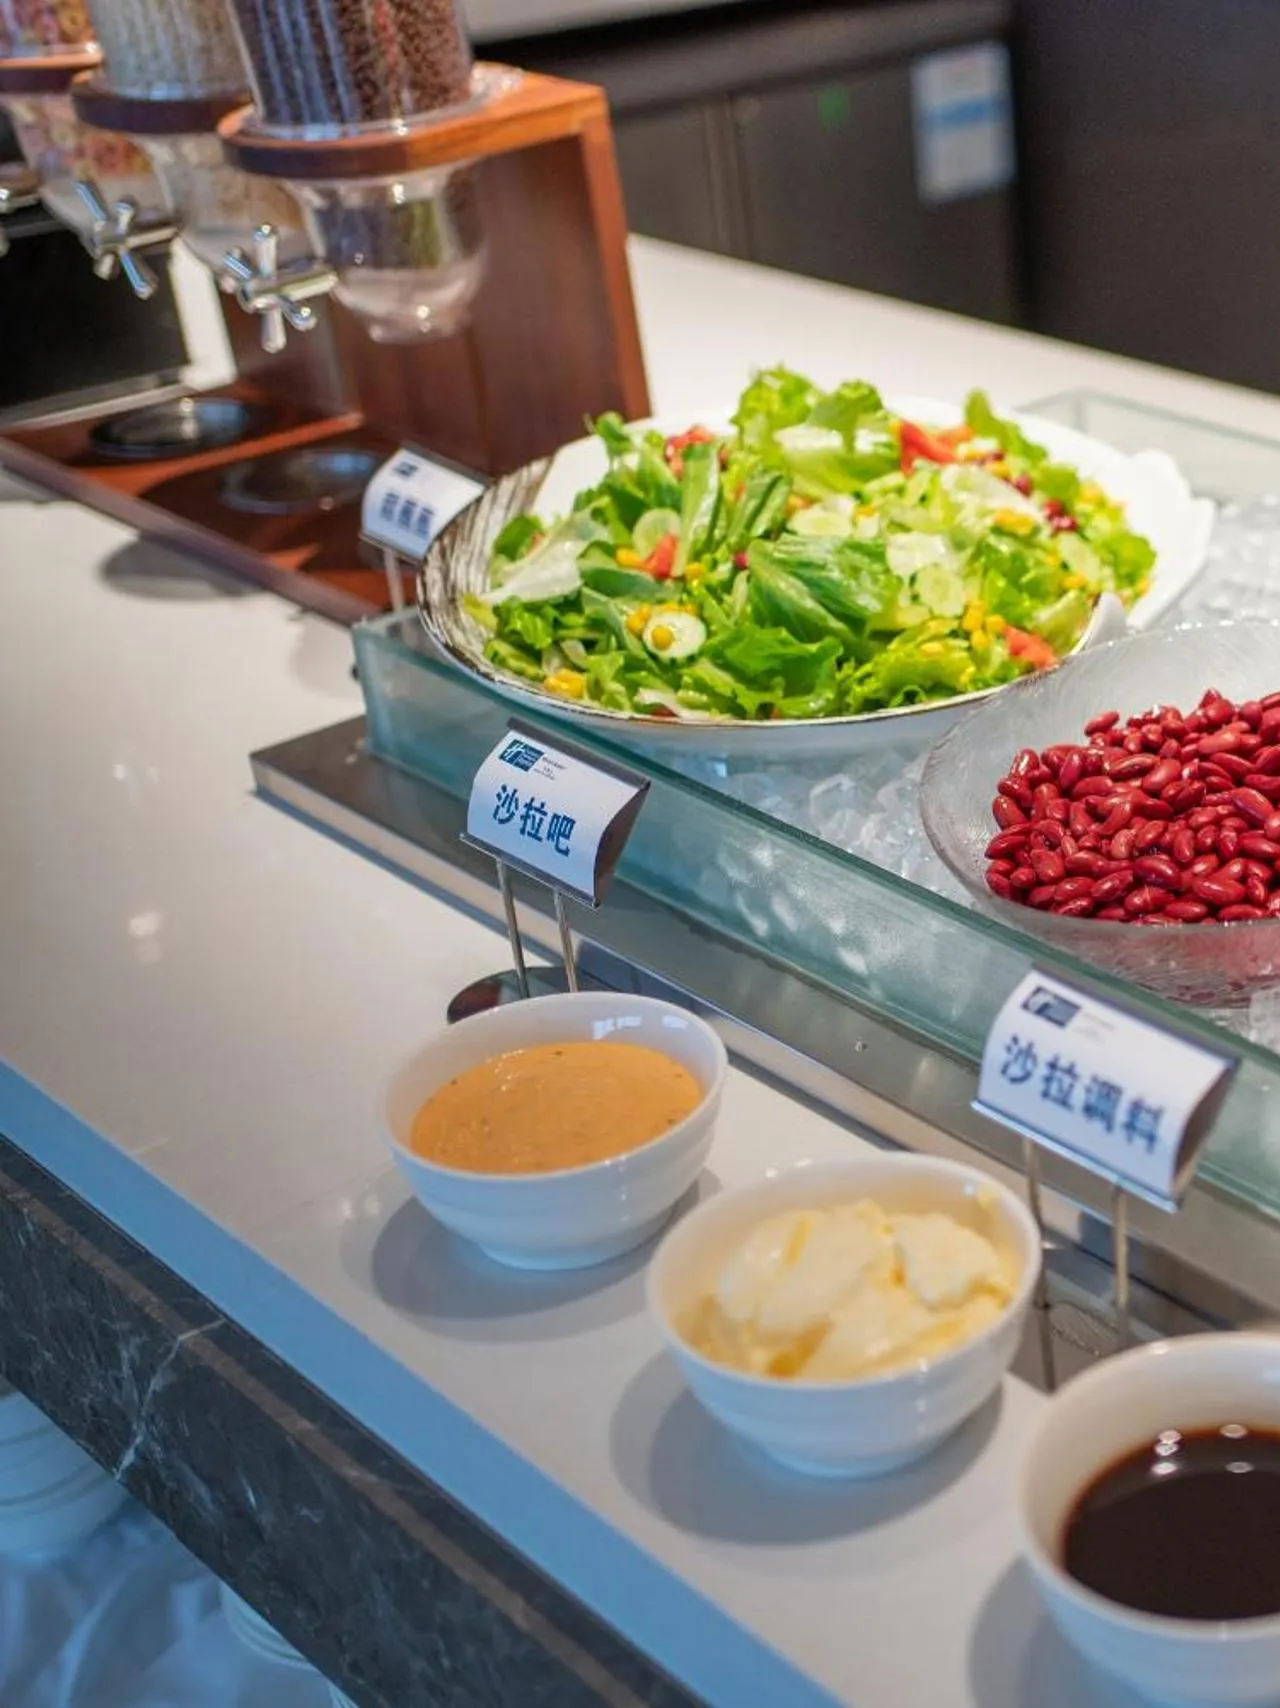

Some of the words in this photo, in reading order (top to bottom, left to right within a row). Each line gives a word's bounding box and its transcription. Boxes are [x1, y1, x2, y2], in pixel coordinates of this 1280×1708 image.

[492, 784, 576, 858] 沙拉吧
[999, 1034, 1165, 1155] 沙拉调料
